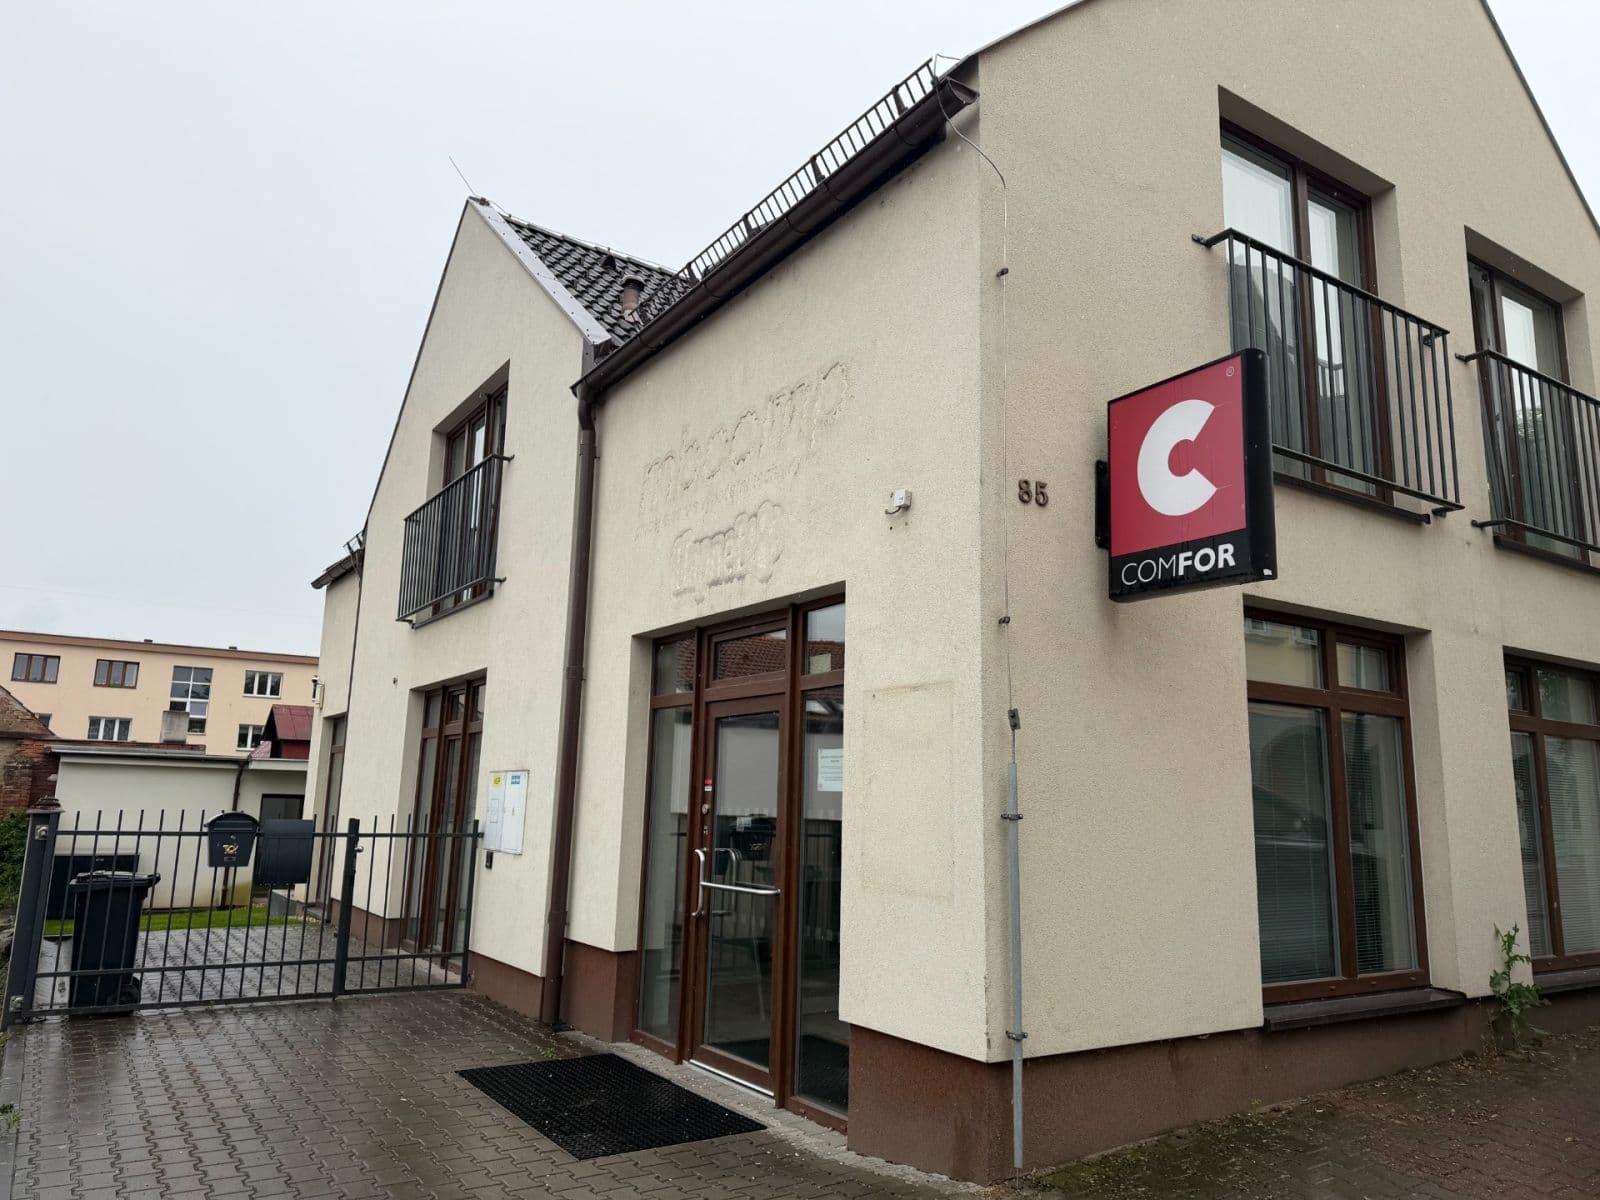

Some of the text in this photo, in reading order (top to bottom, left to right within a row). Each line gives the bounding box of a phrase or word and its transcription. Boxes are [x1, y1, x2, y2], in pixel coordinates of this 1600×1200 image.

[1137, 399, 1218, 517] C
[1018, 479, 1049, 507] 85
[1121, 543, 1236, 586] COMFOR
